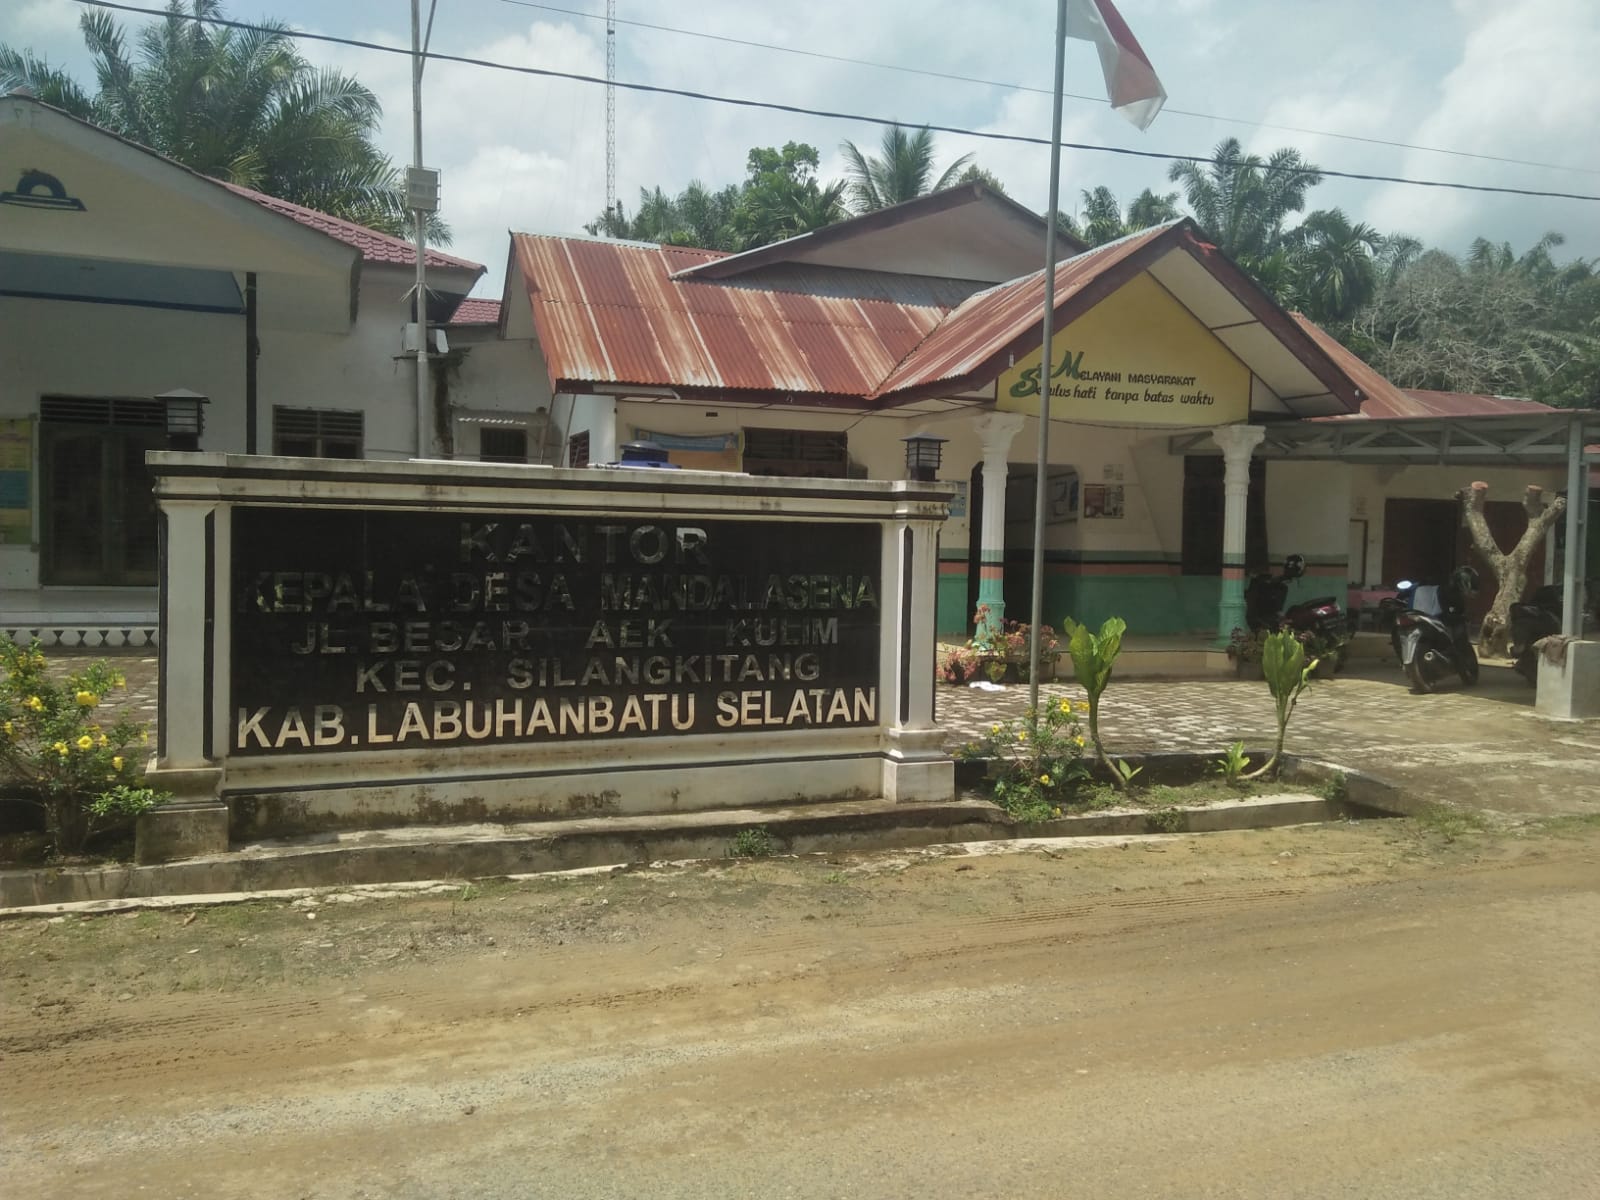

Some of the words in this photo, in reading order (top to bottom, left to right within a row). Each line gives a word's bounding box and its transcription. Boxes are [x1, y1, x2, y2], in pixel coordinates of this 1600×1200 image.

[1010, 366, 1071, 397] Seulus
[1073, 384, 1097, 399] hati
[1105, 388, 1139, 404] tanpa
[1144, 388, 1174, 403] batas
[1180, 390, 1214, 405] waktu
[1128, 373, 1196, 387] MASYARAKAT
[459, 522, 711, 565] KANTOR
[237, 570, 427, 613] KEPALA
[450, 571, 576, 612] DESA
[600, 573, 880, 611] MANDALASENA
[370, 620, 532, 653] BESAR
[585, 619, 674, 649] AEK
[726, 617, 839, 647] KULIM
[356, 660, 471, 693] KEC.
[506, 653, 820, 689] SILANGKITANG
[715, 687, 876, 728] SELATAN
